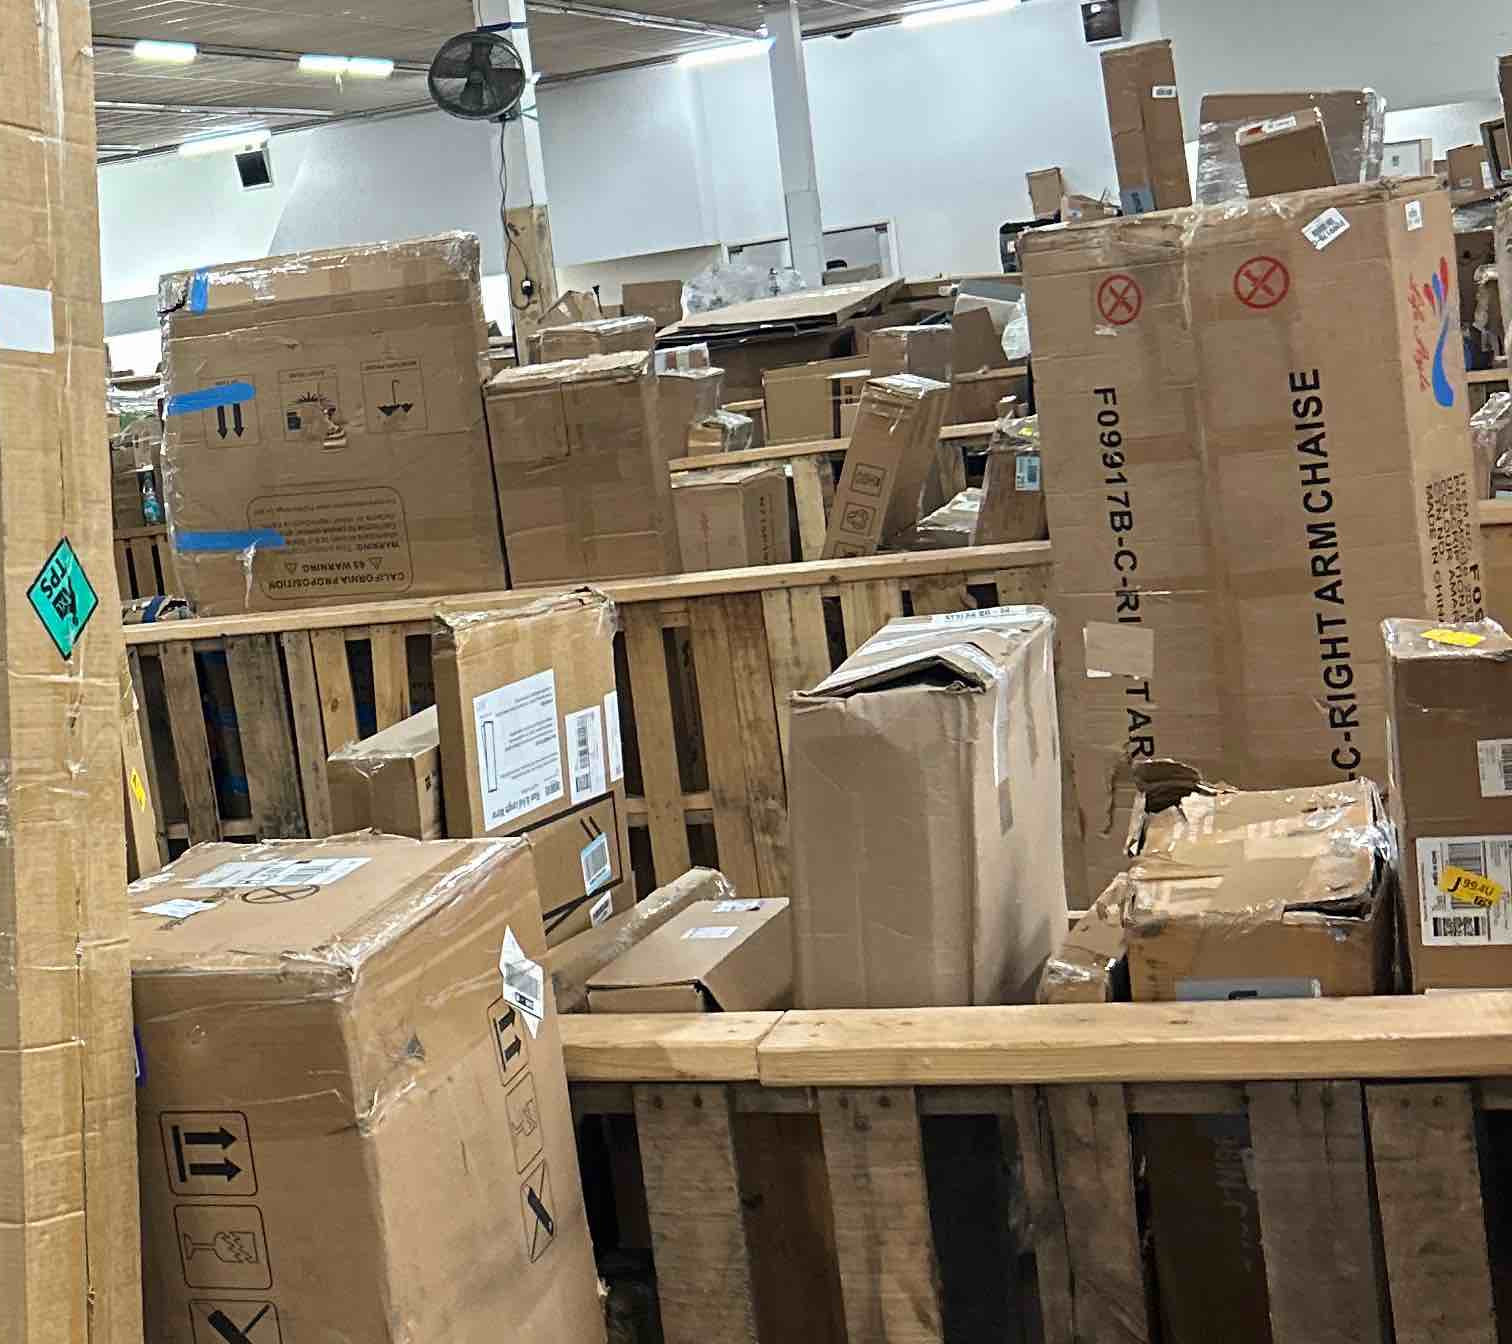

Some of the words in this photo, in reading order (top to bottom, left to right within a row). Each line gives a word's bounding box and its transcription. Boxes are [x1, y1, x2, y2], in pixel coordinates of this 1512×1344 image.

[1289, 368, 1333, 514] CHAISE
[1424, 483, 1438, 538] MADE
[302, 561, 351, 573] WARNING
[1306, 522, 1345, 605] ARM
[1430, 545, 1441, 565] IN
[40, 558, 67, 599] TPS
[268, 575, 338, 590] PROPOSITION
[341, 571, 405, 585] CALIFORNIA
[1126, 708, 1155, 759] AR
